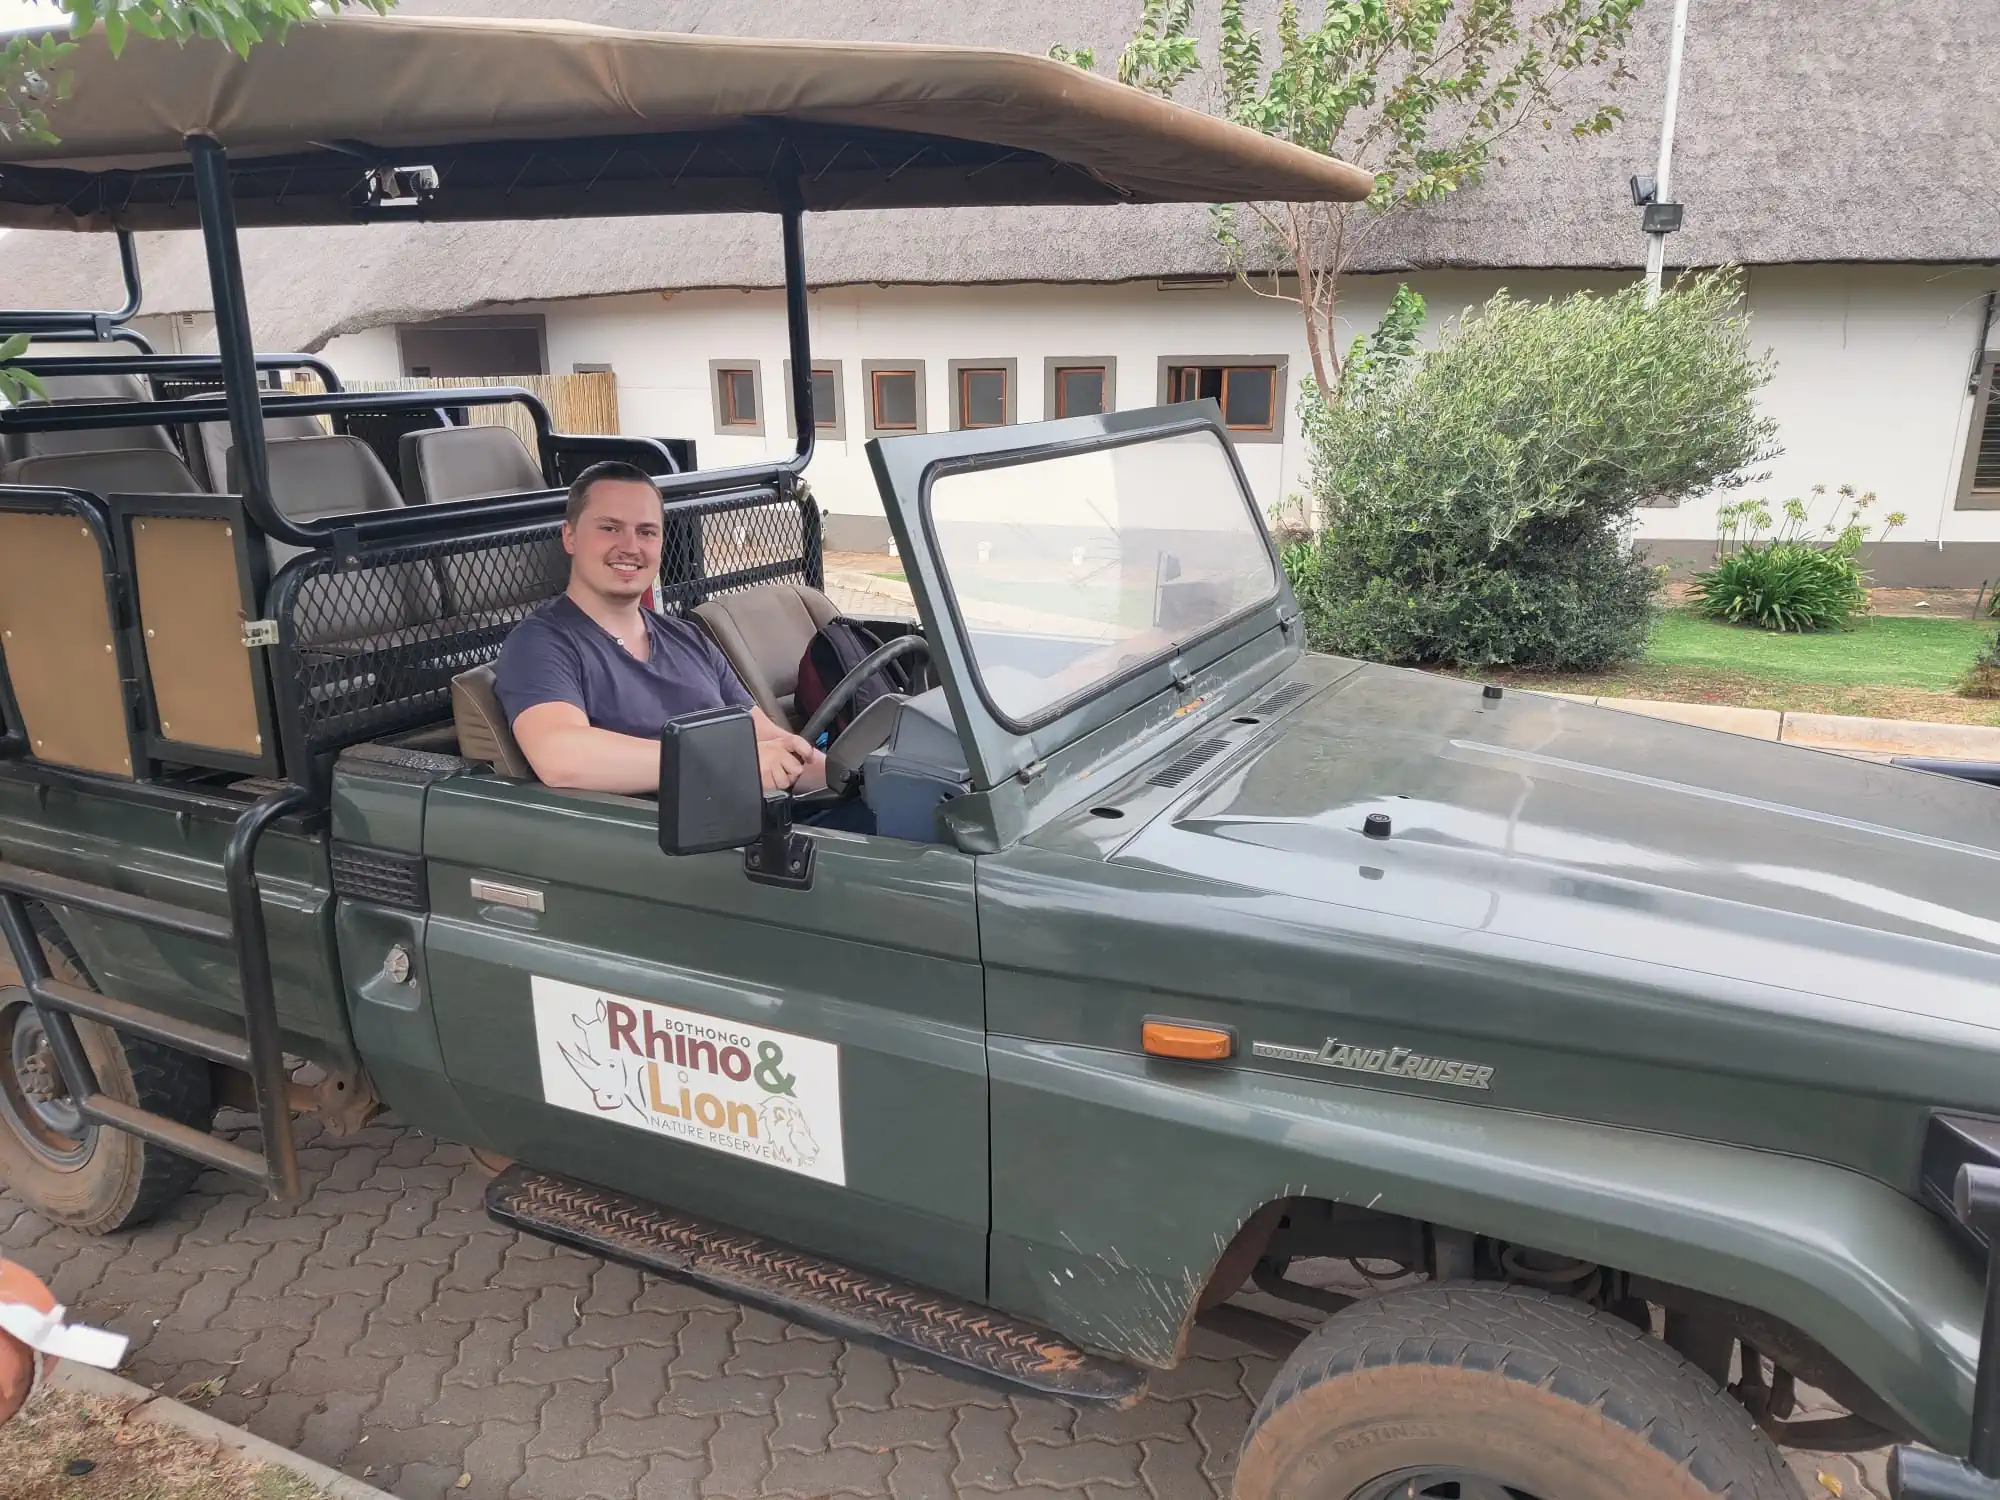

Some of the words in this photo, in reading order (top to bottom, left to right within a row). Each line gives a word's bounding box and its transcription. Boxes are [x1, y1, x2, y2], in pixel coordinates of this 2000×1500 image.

[607, 1000, 752, 1082] Rhino
[753, 1040, 798, 1098] &
[665, 1018, 751, 1048] BOTHONGO
[1255, 1043, 1314, 1063] TOYOTA
[647, 1061, 758, 1139] Lion
[650, 1115, 705, 1140] NATURE
[709, 1131, 771, 1158] RESERVE
